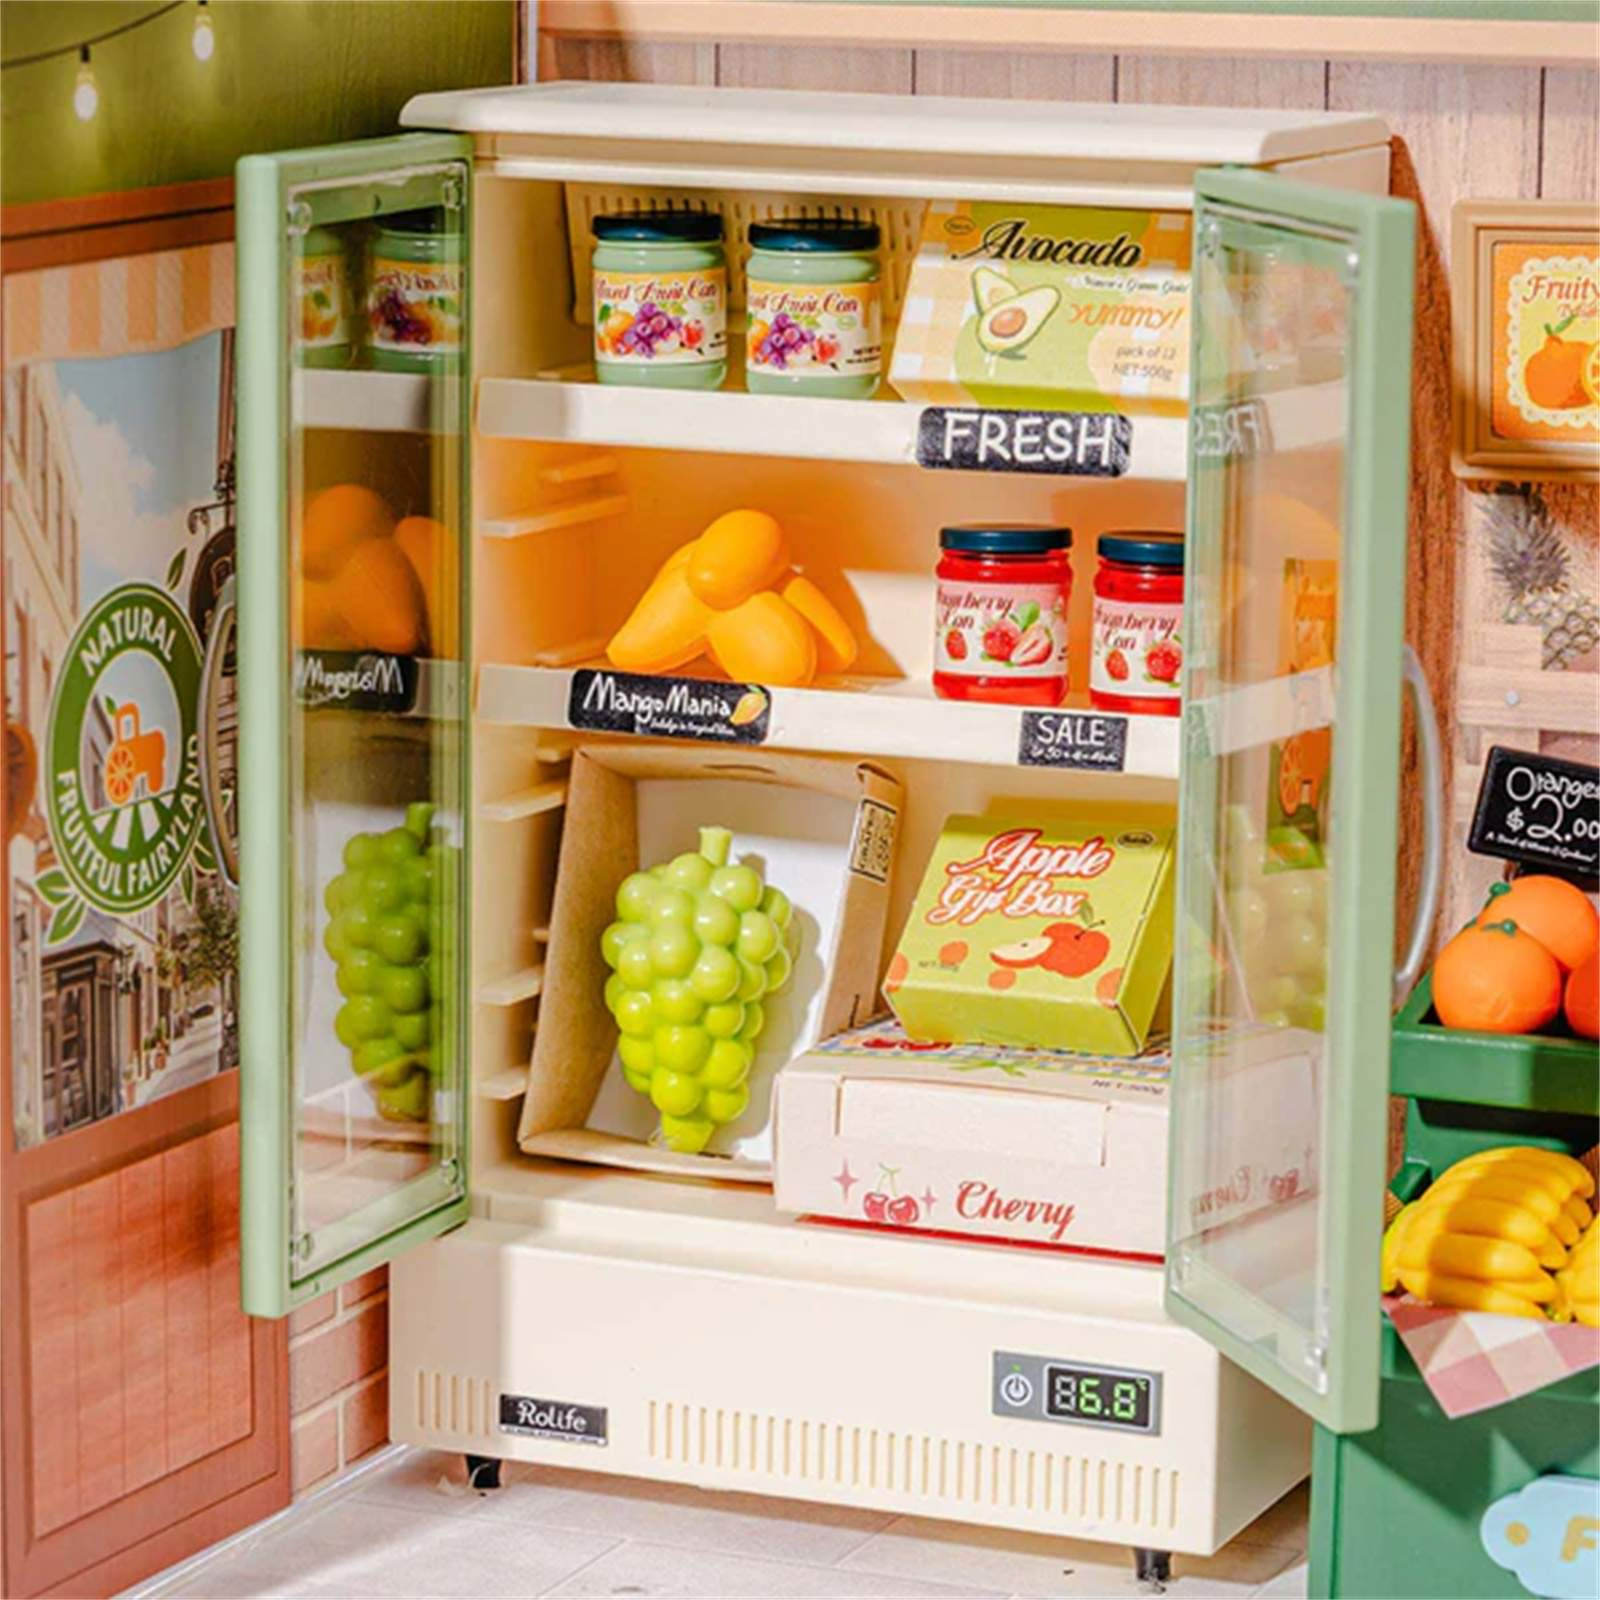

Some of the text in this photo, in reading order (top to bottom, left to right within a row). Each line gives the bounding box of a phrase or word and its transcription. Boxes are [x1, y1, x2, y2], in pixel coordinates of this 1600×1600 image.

[951, 220, 1142, 269] Avocado
[943, 411, 1113, 467] FRESH
[79, 606, 177, 677] NATURAL
[1037, 715, 1106, 746] SALE
[56, 768, 123, 896] FRUITFUL
[946, 828, 1115, 891] Apple
[926, 873, 1090, 925] Gift Box
[955, 1181, 1076, 1240] Cherry
[517, 1399, 587, 1432] Rolife
